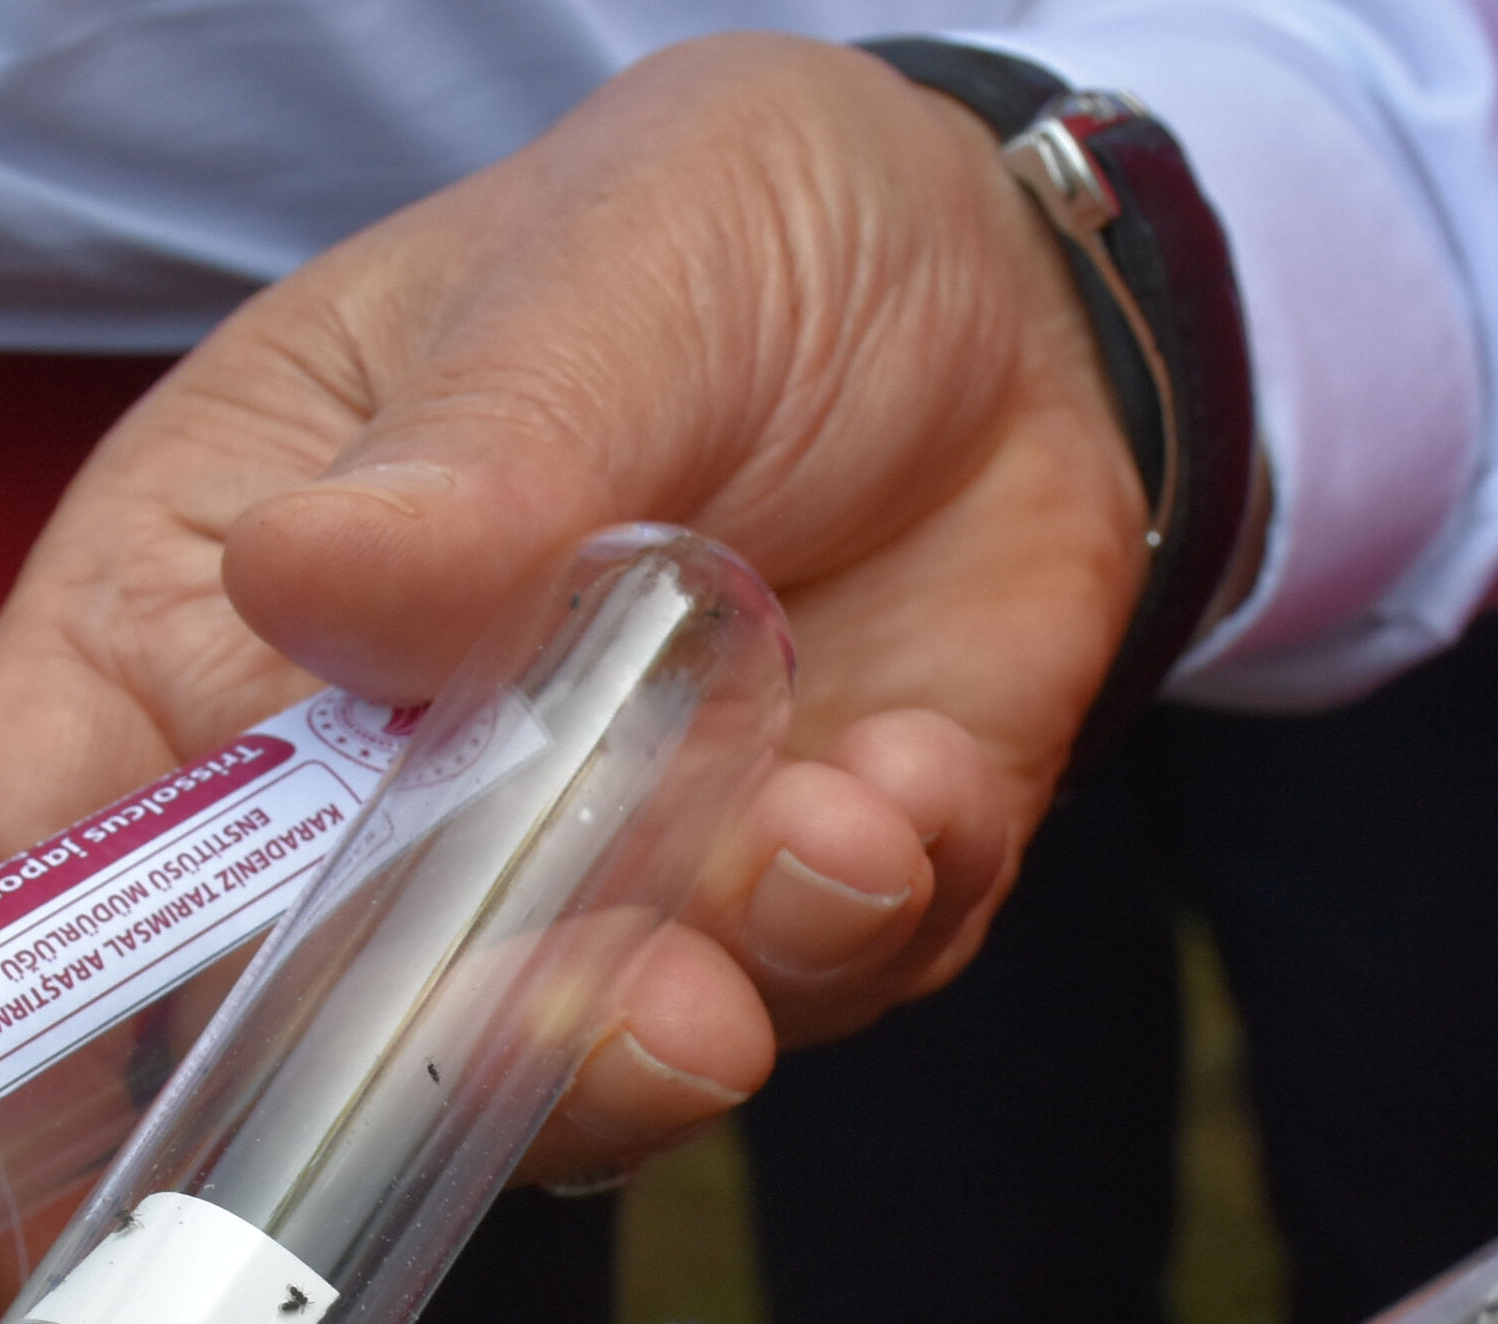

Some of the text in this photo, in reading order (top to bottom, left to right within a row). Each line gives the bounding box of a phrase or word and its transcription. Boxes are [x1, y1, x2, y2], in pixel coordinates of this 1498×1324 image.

[83, 743, 265, 843] Trissolcus
[147, 807, 271, 891] ENSTİTÜSÜ
[214, 803, 345, 893] KARADENİZ
[0, 880, 150, 982] MÜDÜRLÜĞÜ
[102, 882, 221, 958] TARIMSAL
